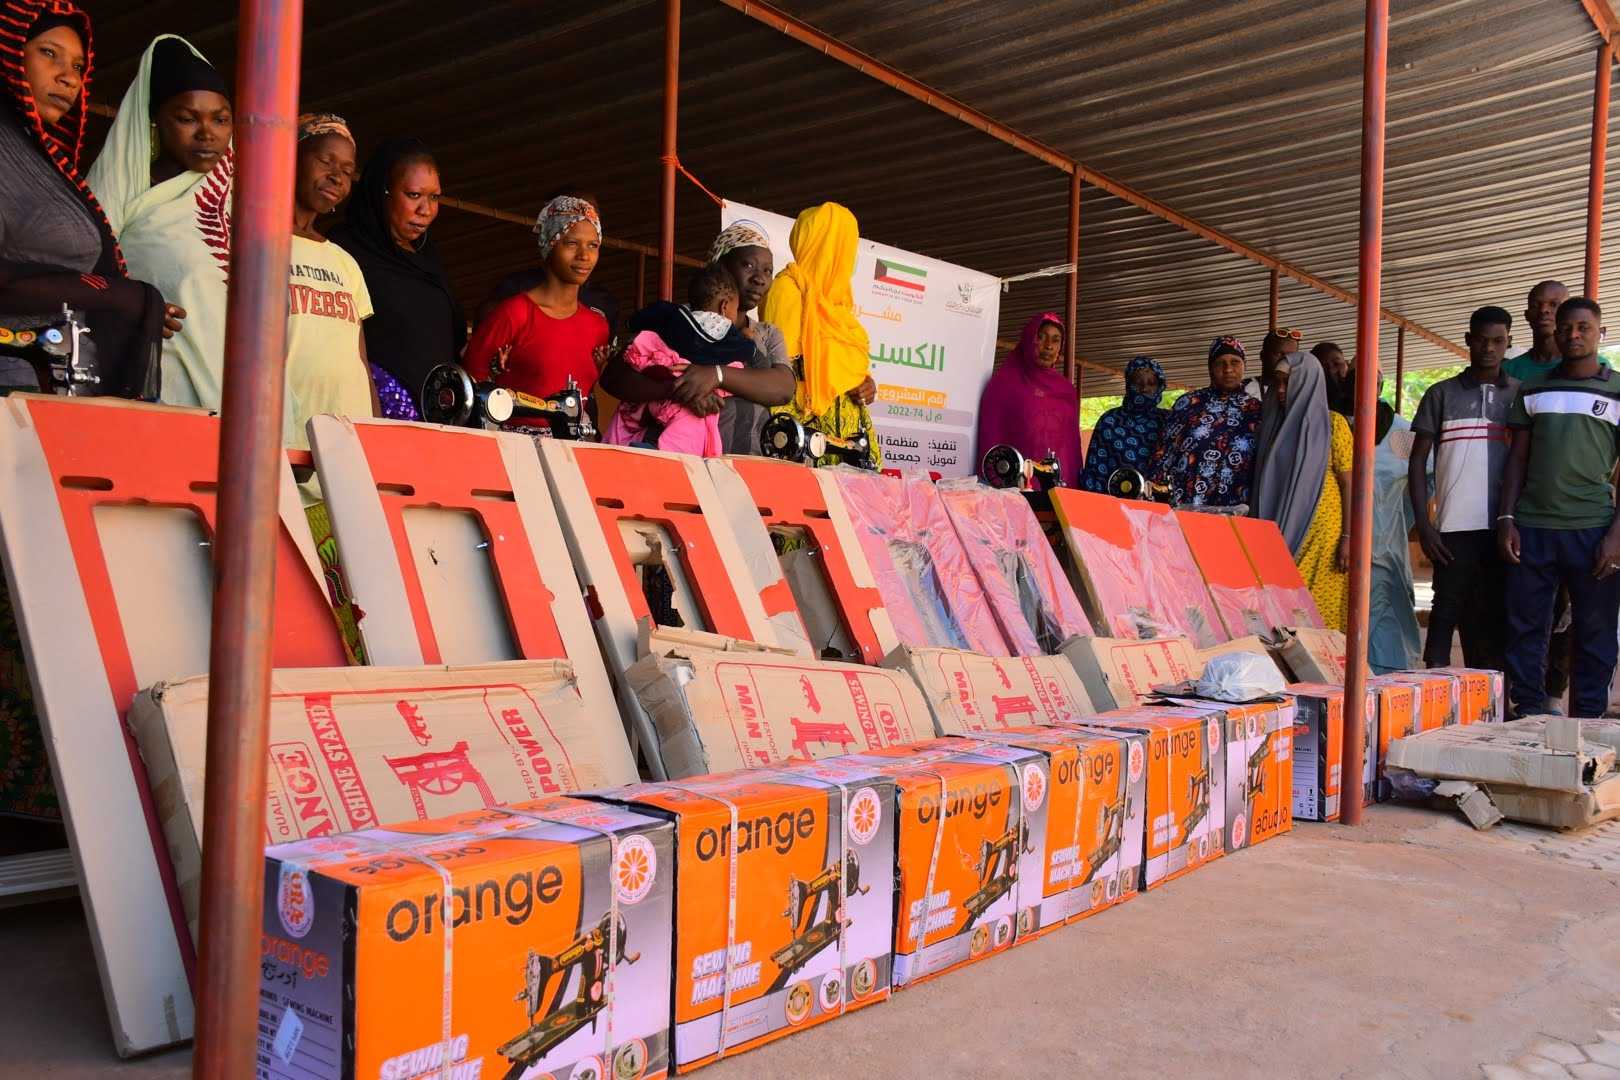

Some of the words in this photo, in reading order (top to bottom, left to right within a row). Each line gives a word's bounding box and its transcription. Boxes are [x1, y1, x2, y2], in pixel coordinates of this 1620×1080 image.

[885, 449, 921, 465] جمعية
[886, 436, 919, 449] منظمة
[735, 685, 762, 739] MAN
[502, 708, 561, 794] POWER
[696, 807, 815, 861] orange
[386, 865, 563, 942] orange
